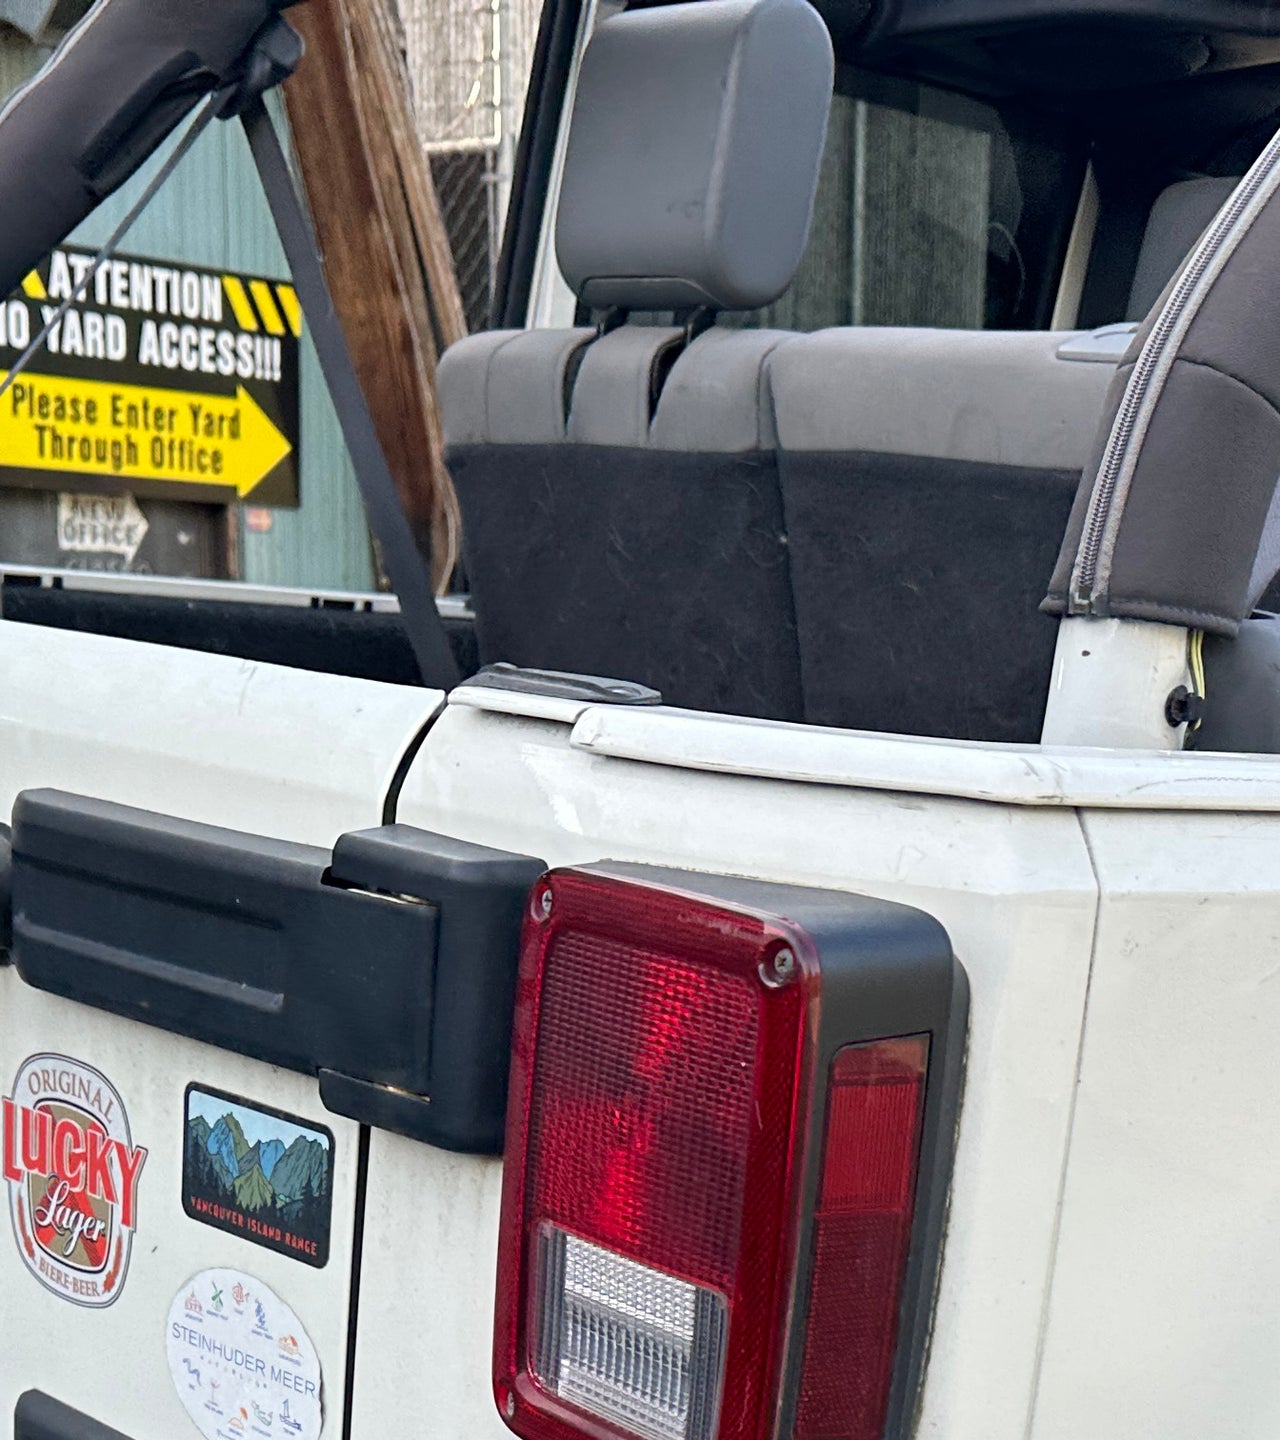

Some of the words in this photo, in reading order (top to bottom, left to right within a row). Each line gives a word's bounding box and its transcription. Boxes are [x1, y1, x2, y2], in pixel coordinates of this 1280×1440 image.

[47, 250, 223, 322] ATTENTION
[40, 304, 127, 362] YARD
[139, 320, 282, 382] ACCESS!!!
[11, 383, 98, 424] Please
[111, 386, 177, 432] Enter
[187, 404, 241, 439] Yard
[34, 424, 139, 471] Through
[150, 437, 223, 475] Office
[27, 1069, 115, 1124] ORIGINAL
[3, 1096, 148, 1233] LUCKY
[35, 1180, 106, 1256] Lager
[190, 1195, 244, 1228] VANCOUVER
[247, 1216, 282, 1242] ISLAND
[284, 1232, 318, 1257] RANGE
[172, 1321, 267, 1377] STEINHUDER
[270, 1365, 316, 1399] MEER
